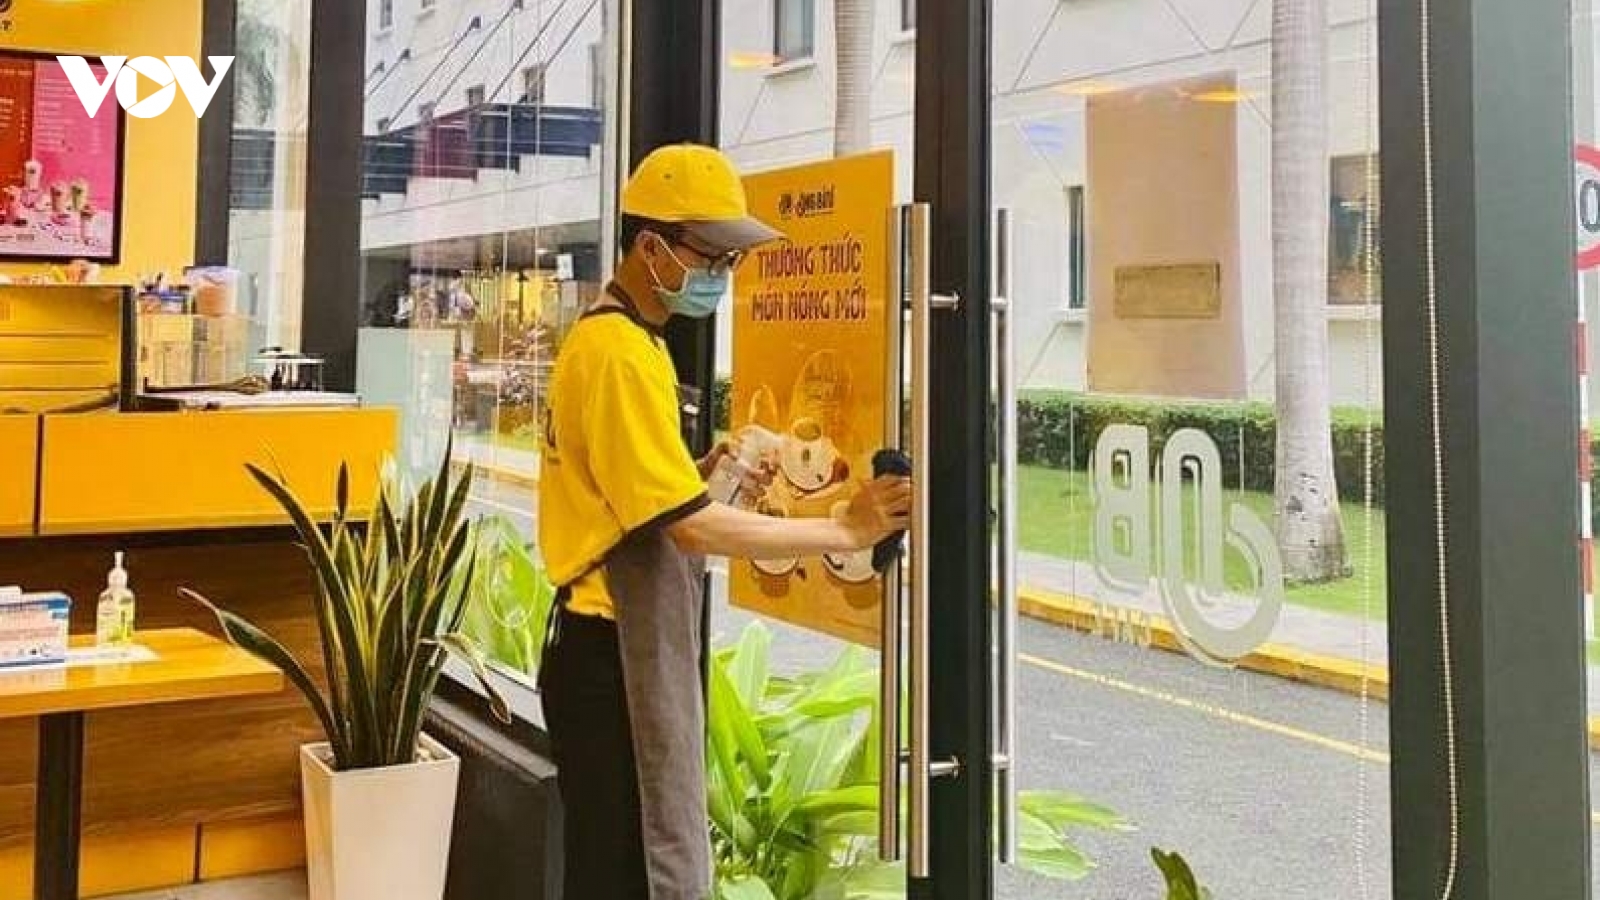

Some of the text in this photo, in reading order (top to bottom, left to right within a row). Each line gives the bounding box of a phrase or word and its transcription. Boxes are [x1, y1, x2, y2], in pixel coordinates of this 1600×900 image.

[820, 231, 863, 276] THỨC
[788, 280, 831, 321] NÓNG
[834, 278, 868, 320] MỚI
